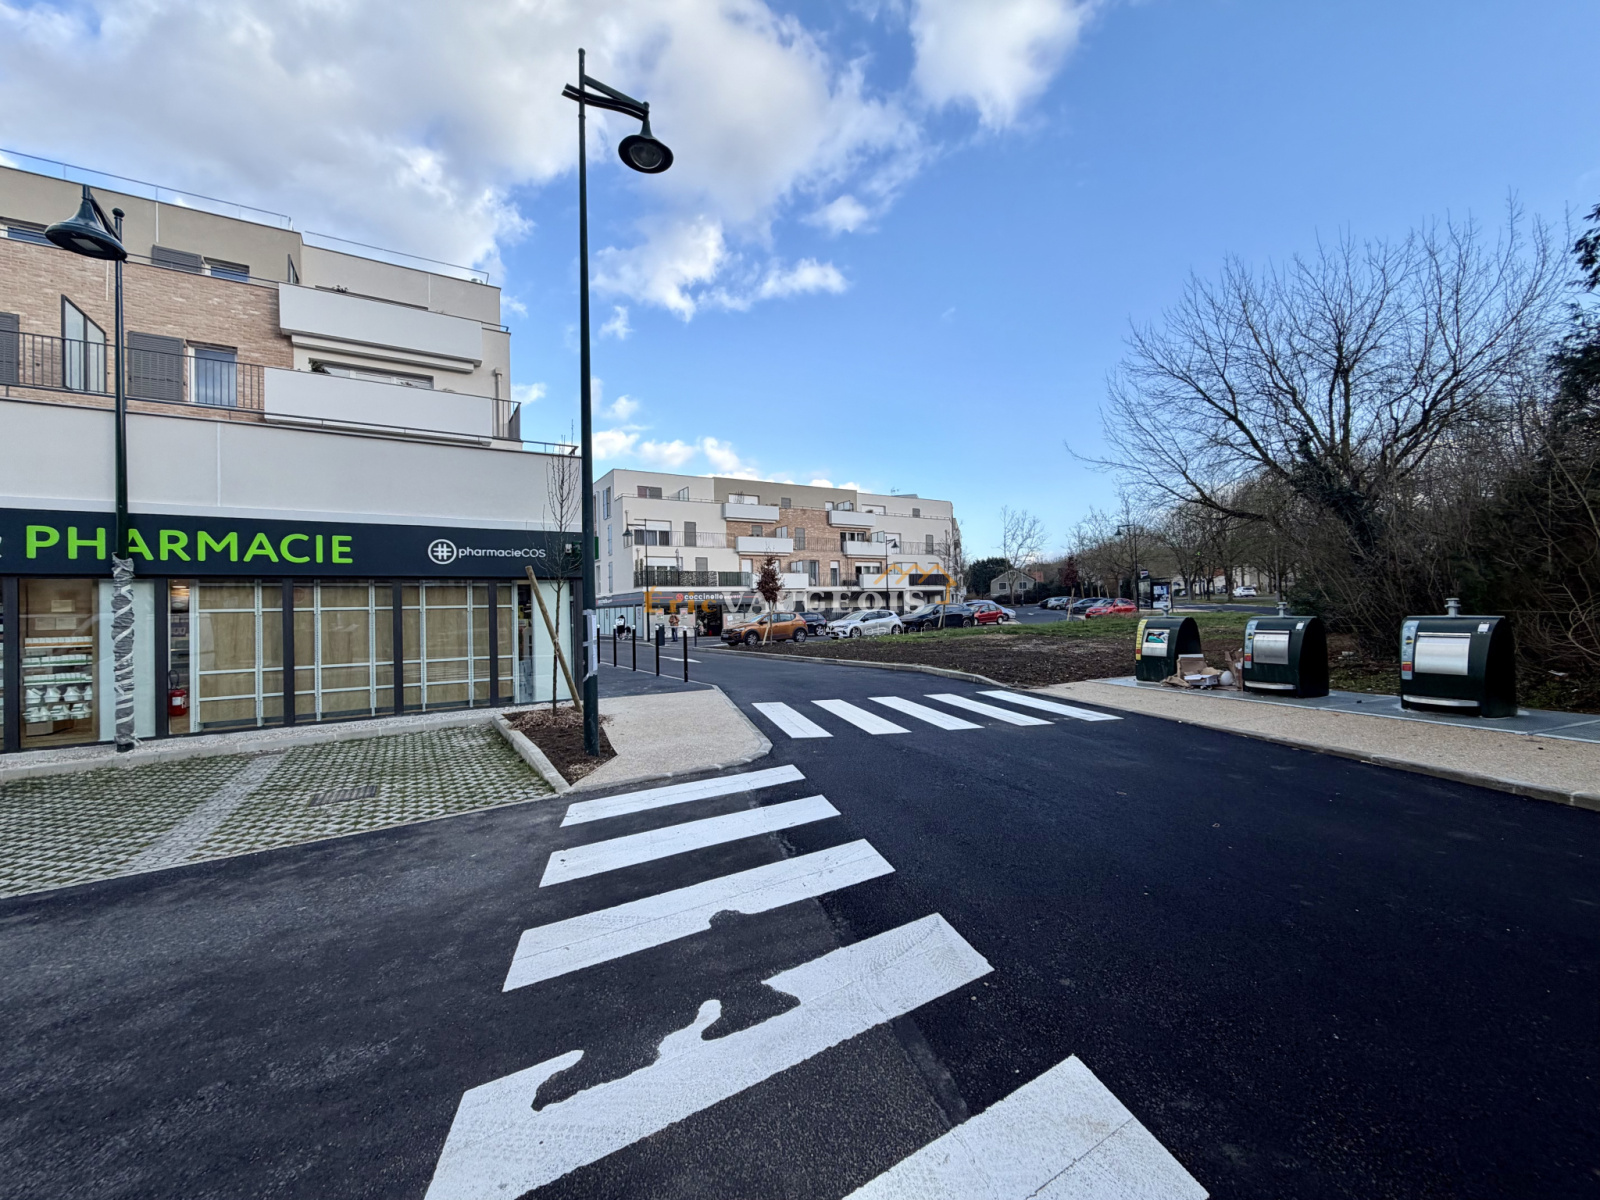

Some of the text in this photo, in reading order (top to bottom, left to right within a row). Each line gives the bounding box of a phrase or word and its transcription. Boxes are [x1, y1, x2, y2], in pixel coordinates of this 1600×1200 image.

[26, 525, 353, 564] PHARMACIE
[458, 547, 546, 558] pharmacieCOS
[684, 593, 723, 601] coccinelle
